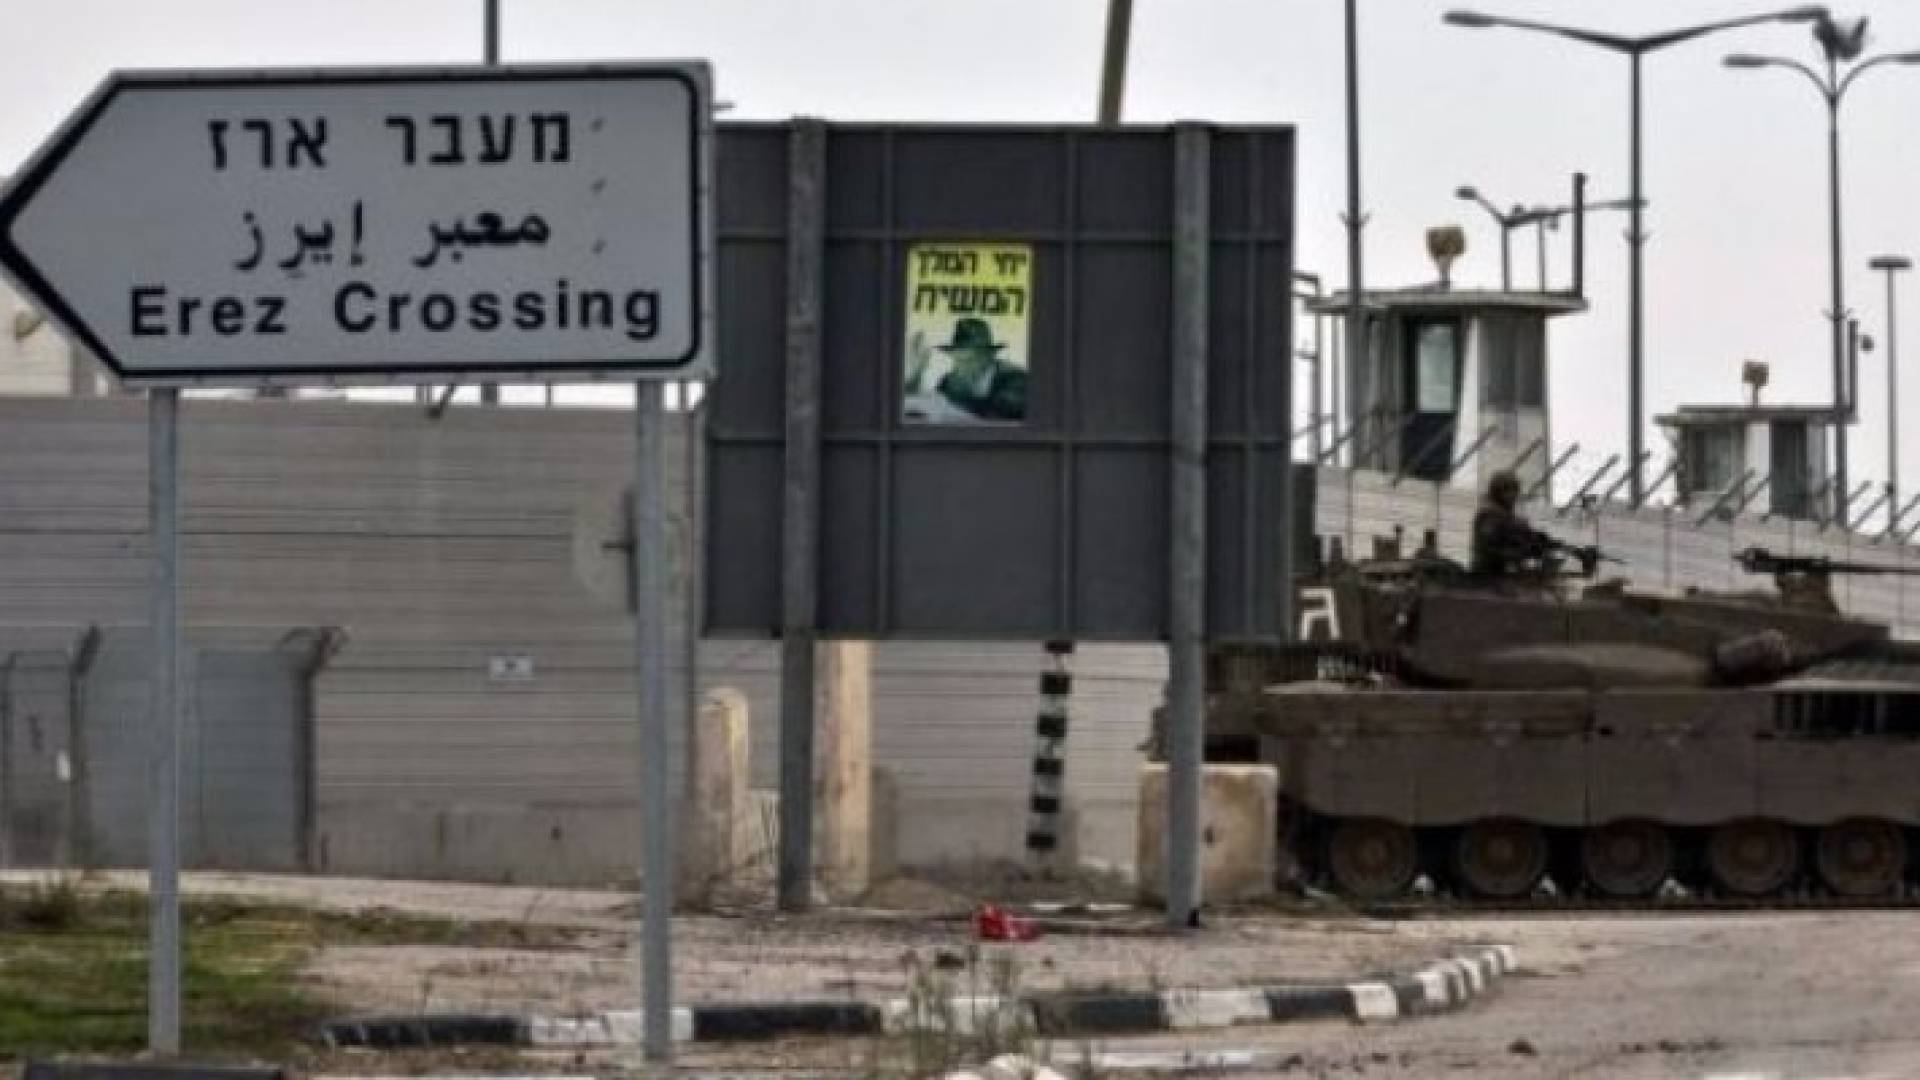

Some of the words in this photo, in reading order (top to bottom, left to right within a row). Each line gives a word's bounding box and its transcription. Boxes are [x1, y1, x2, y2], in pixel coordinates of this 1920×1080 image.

[207, 117, 327, 171] ארז
[385, 112, 570, 165] מעבר
[411, 209, 551, 269] معبر
[129, 284, 288, 336] Erez
[332, 277, 662, 342] Crossing
